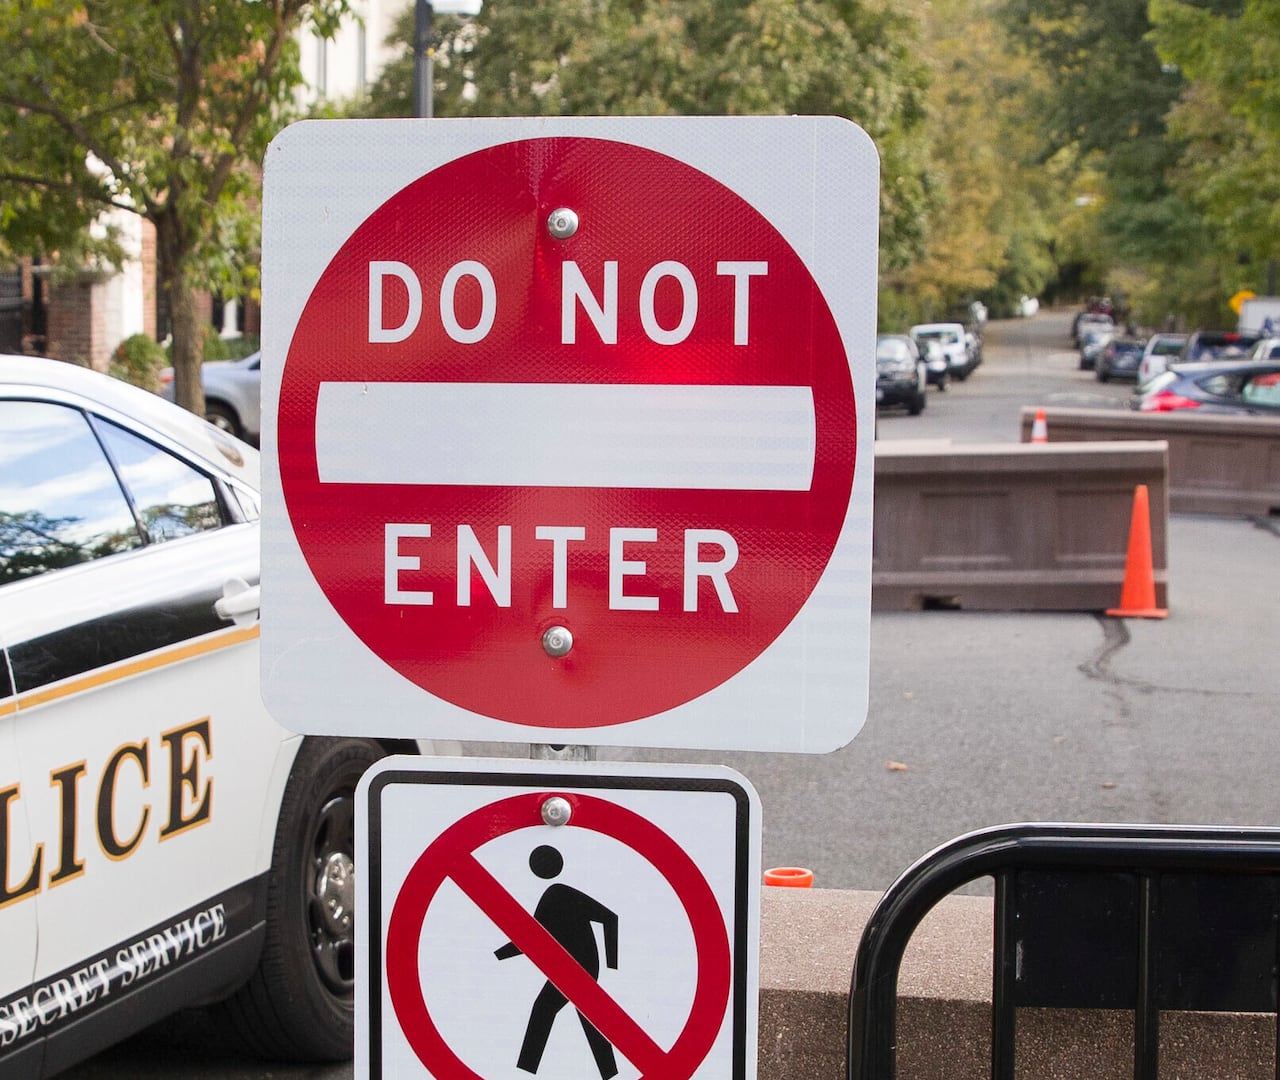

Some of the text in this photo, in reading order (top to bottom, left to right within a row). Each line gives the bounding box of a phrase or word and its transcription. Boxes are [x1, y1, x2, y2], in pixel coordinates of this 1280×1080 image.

[368, 260, 768, 346] DO NOT
[384, 523, 739, 613] ENTER
[115, 903, 228, 986] SERVICE
